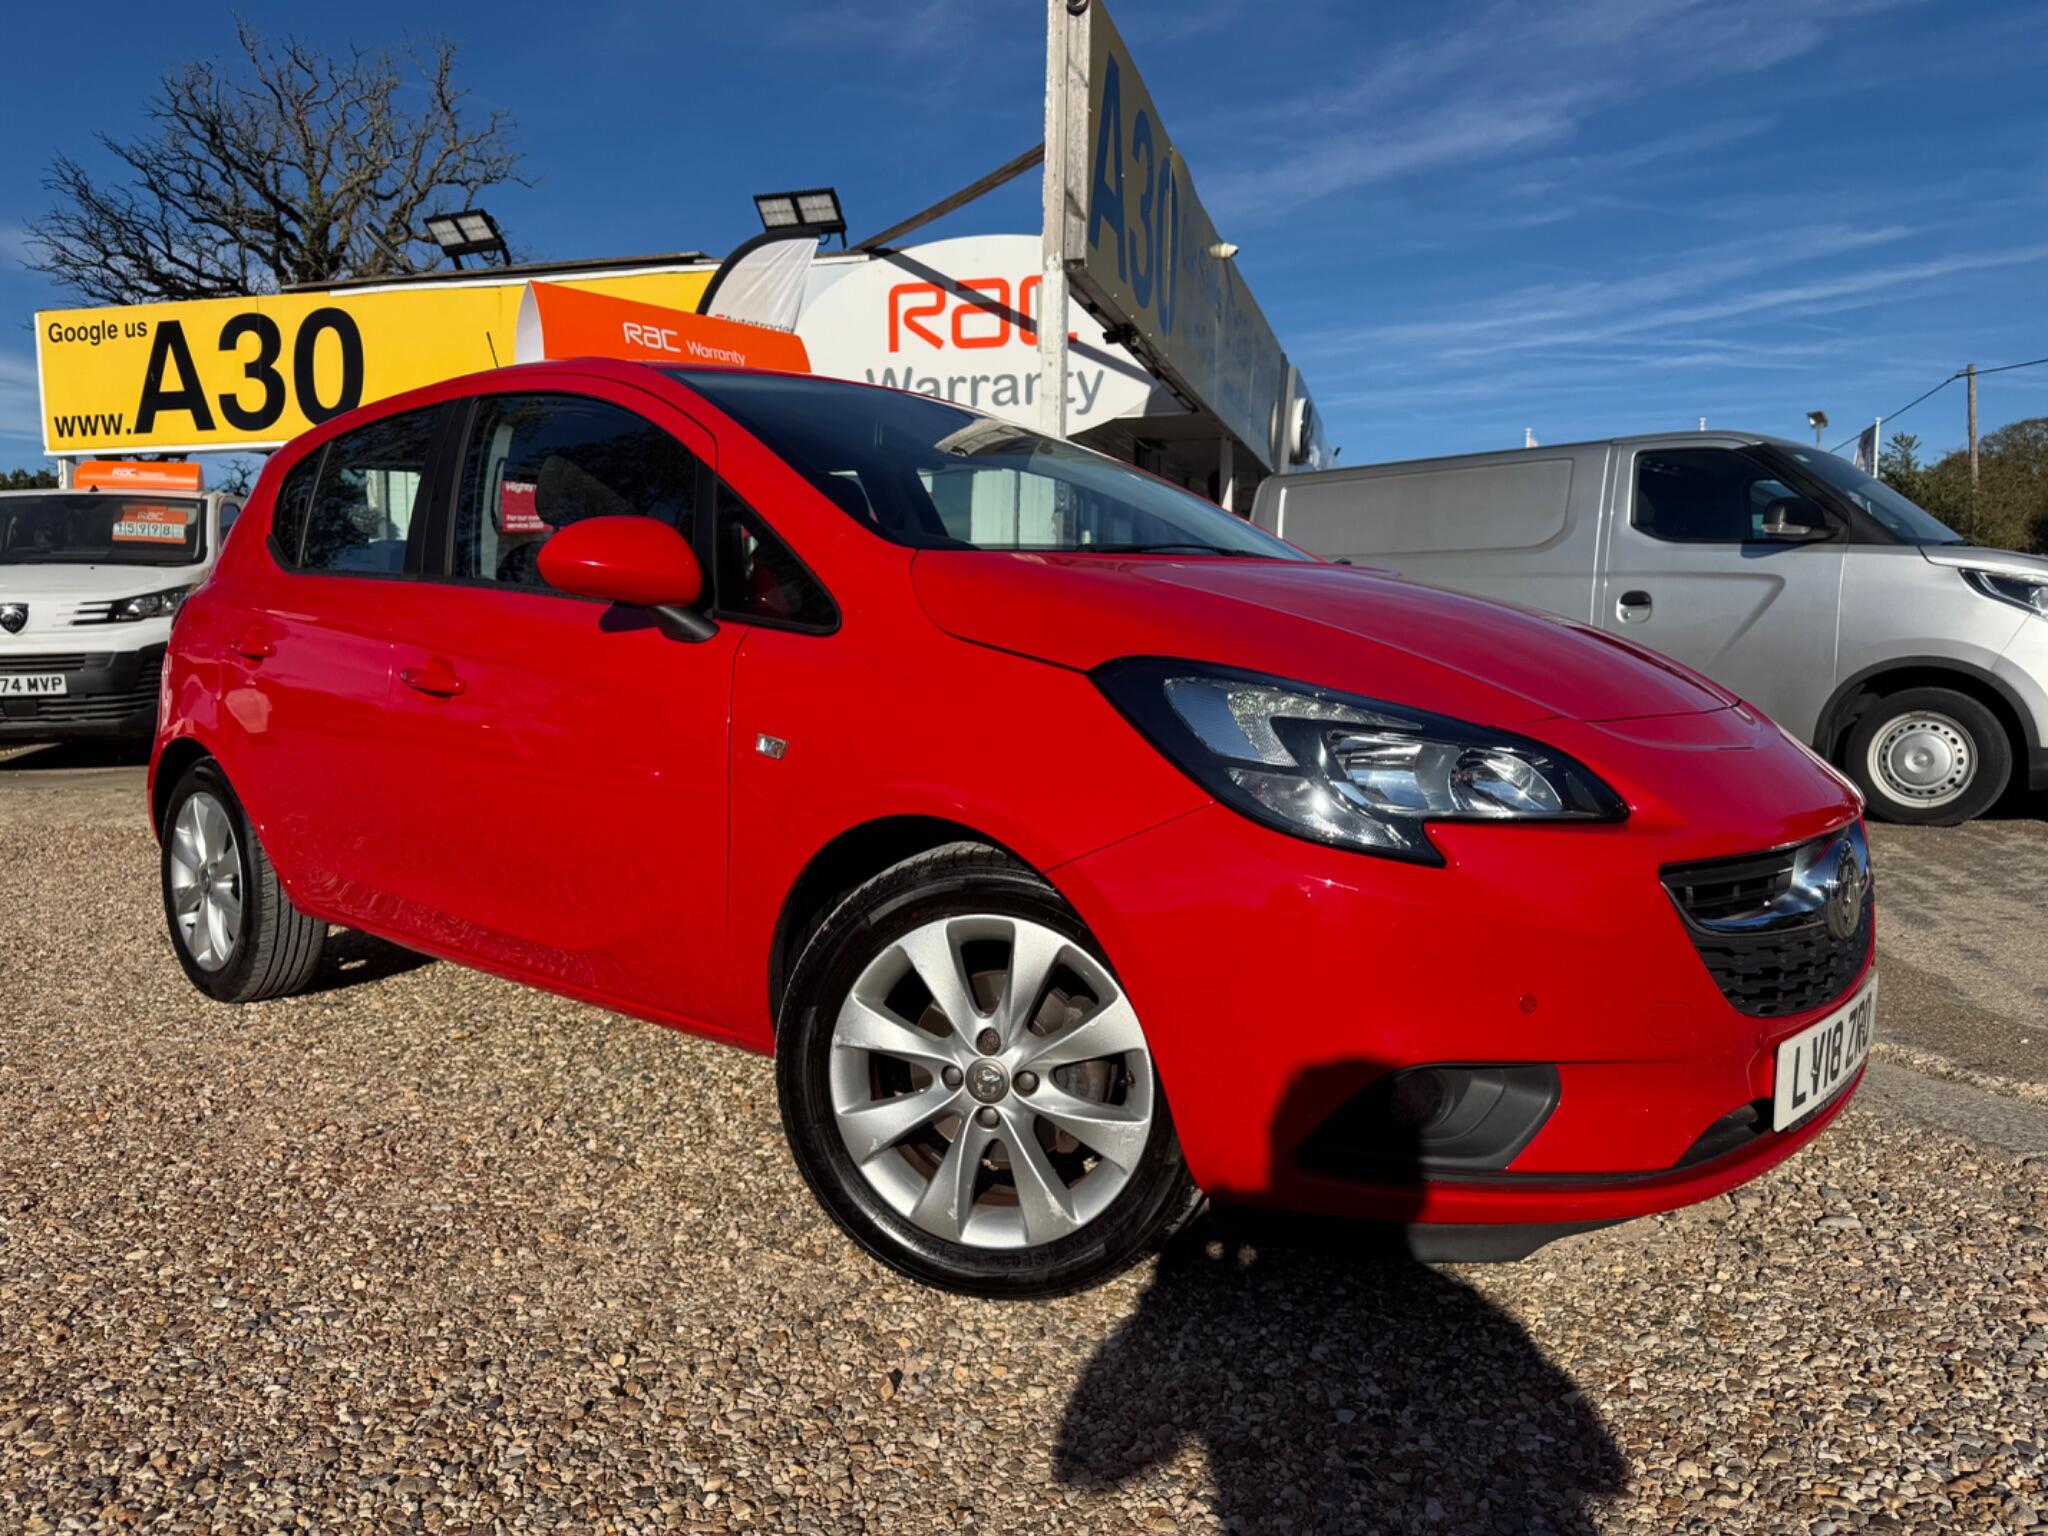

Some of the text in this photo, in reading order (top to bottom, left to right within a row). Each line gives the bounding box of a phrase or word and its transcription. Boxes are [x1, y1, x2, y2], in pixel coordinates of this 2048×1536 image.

[1089, 52, 1178, 336] A30
[48, 320, 147, 346] Google us
[686, 340, 745, 367] Warranty
[133, 307, 364, 434] A30
[0, 676, 62, 693] 74 MVP
[1792, 1021, 1843, 1109] LV18
